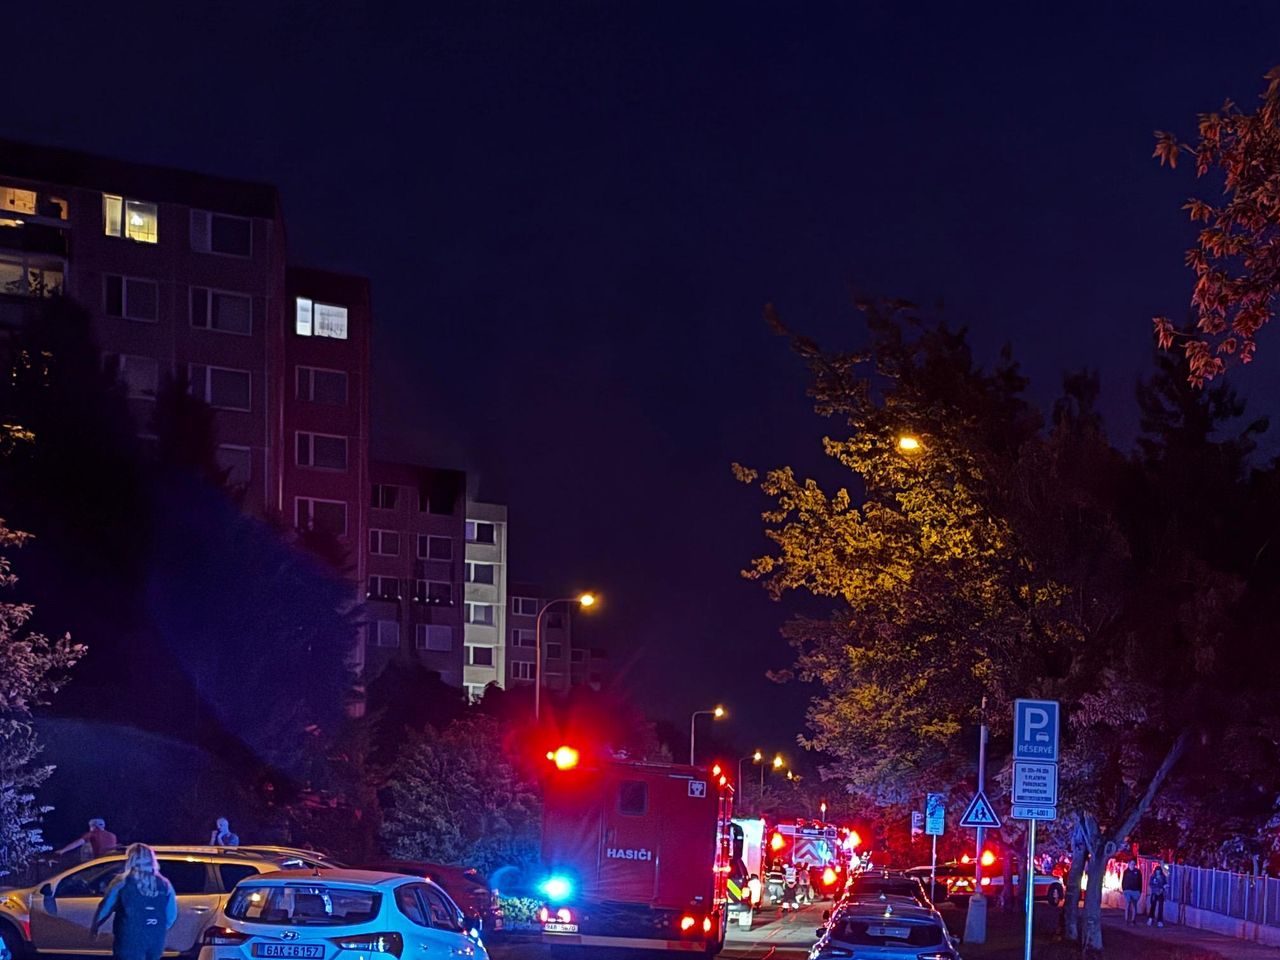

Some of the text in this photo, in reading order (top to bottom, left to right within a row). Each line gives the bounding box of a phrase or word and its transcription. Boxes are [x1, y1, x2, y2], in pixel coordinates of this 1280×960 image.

[1024, 707, 1049, 742] P
[607, 848, 652, 861] HASIČI
[266, 944, 319, 957] 6AK 6157
